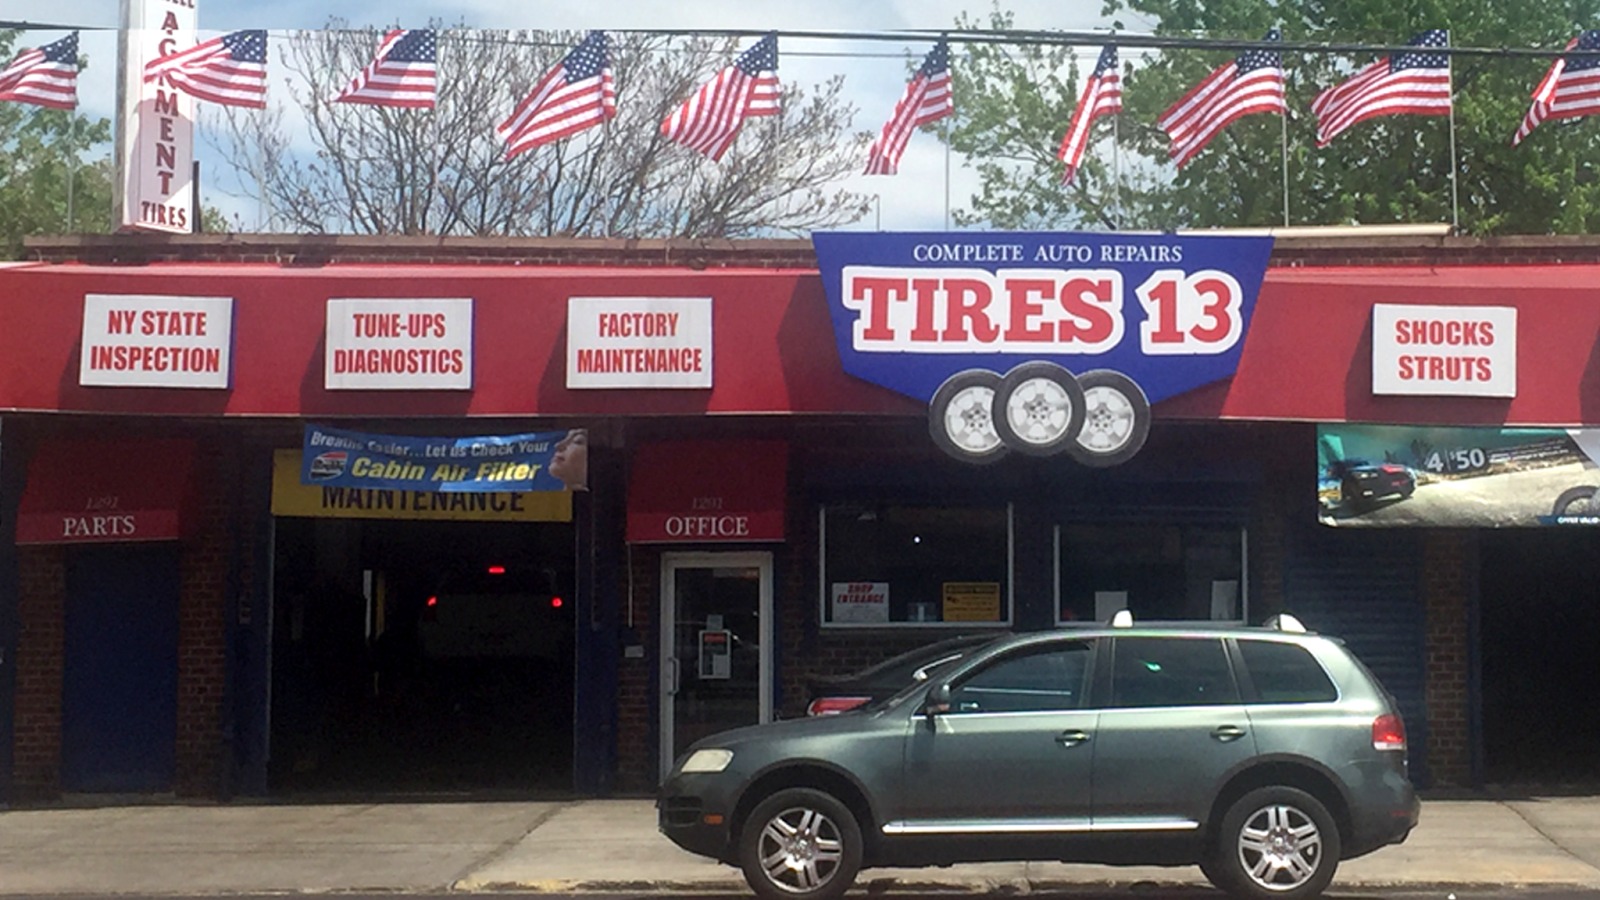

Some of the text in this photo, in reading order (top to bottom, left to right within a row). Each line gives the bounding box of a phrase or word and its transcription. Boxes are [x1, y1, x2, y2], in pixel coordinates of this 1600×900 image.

[141, 201, 187, 228] TIRES
[913, 244, 1182, 262] COMPLETE AUTO REPAIRS
[850, 274, 1233, 345] TIRES 13
[108, 310, 207, 336] NY STATE
[353, 313, 445, 338] TUNE-UPS
[599, 313, 678, 337] FACTORY
[1395, 320, 1494, 346] SHOCKS
[90, 346, 220, 372] INSPECTION
[334, 349, 463, 374] DIAGNOSTICS
[577, 348, 702, 373] MAINTENANCE
[1398, 355, 1492, 381] STRUTS
[450, 446, 467, 458] us
[471, 442, 514, 457] Check
[518, 441, 550, 454] Your
[351, 457, 425, 481] Cabin
[431, 464, 470, 482] Air
[475, 462, 542, 482] Filter
[322, 486, 525, 512] MAINTENANCE
[62, 516, 136, 536] PARTS
[665, 516, 749, 536] OFFICE
